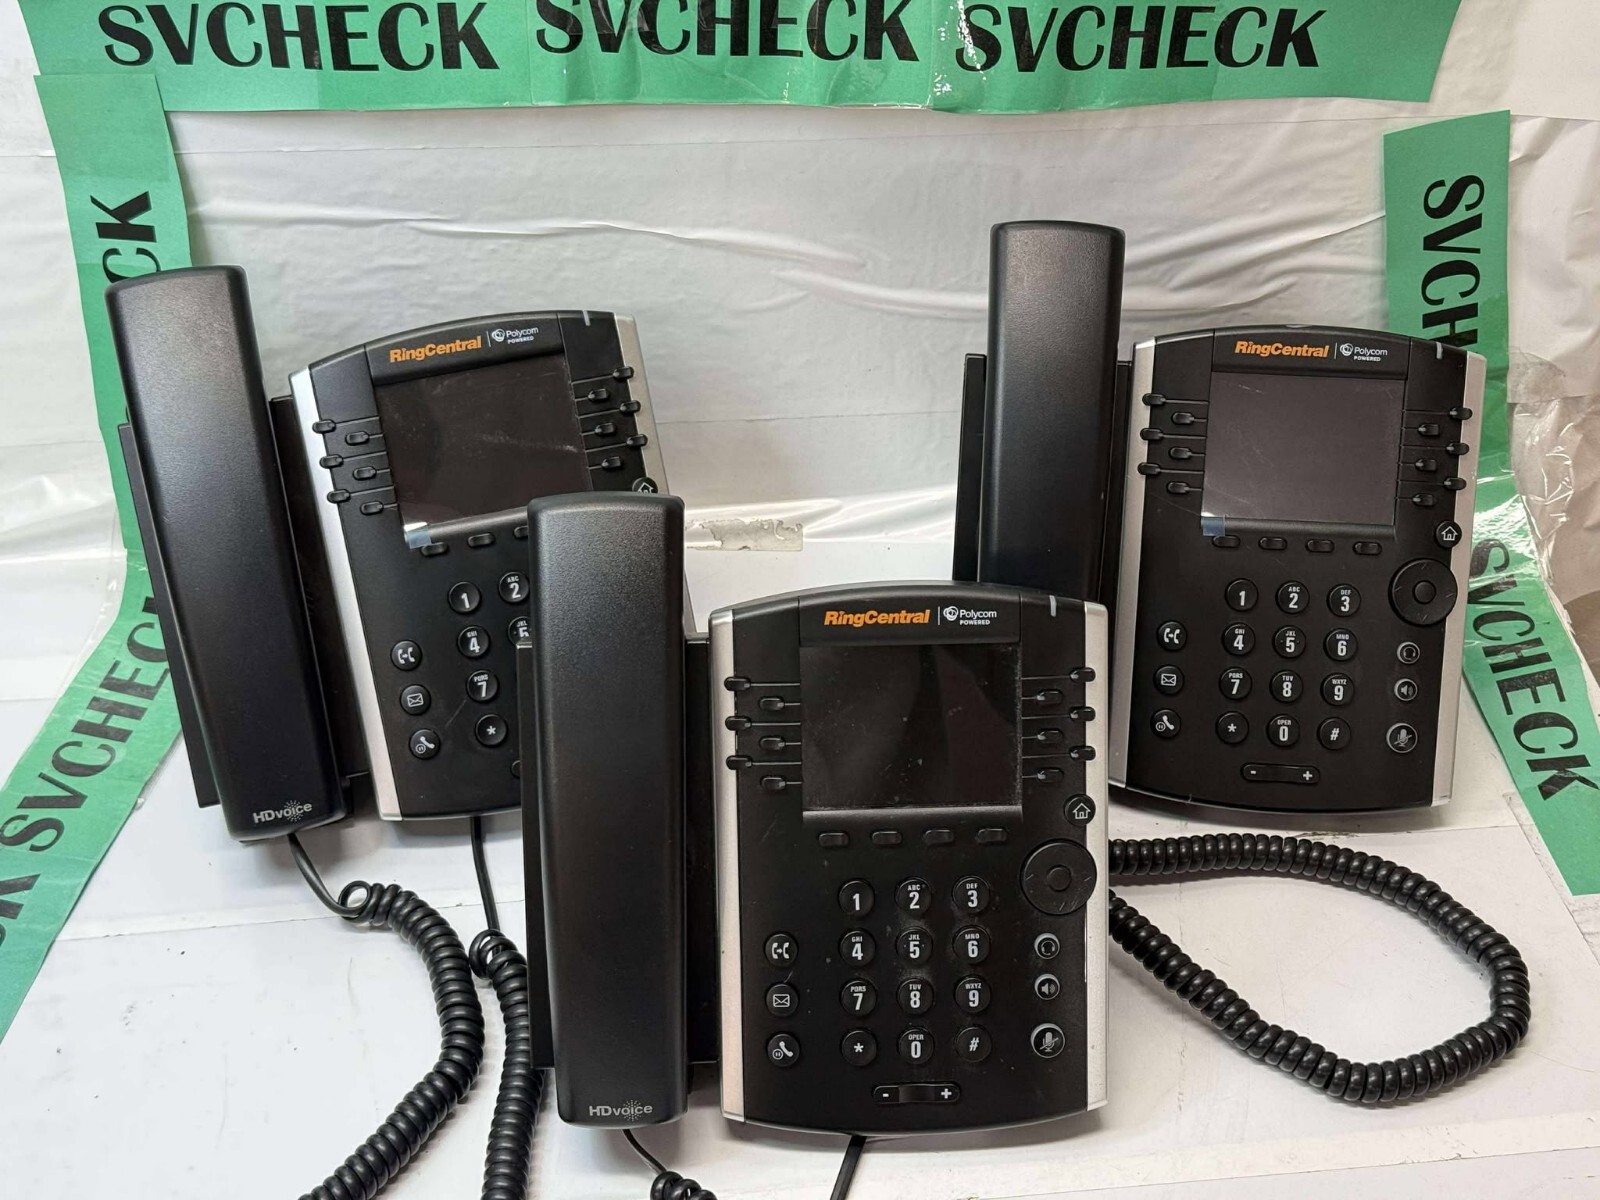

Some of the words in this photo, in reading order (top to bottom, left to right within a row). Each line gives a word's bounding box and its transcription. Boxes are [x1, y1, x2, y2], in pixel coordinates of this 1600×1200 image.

[102, 2, 500, 71] SVCHECK
[536, 0, 920, 62] SVCHECK
[955, 4, 1327, 73] SVCHECK
[506, 327, 539, 338] Polycom
[507, 335, 534, 344] POWERED
[389, 336, 482, 363] RingCentral
[1234, 340, 1330, 358] RingCentral
[1354, 346, 1388, 357] Polycom
[510, 582, 521, 598] 2
[1239, 590, 1246, 606] 1
[461, 593, 470, 609] 1
[1288, 593, 1299, 609] 2
[1340, 596, 1350, 612] 3
[824, 609, 931, 628] RingCentral
[959, 609, 997, 619] Polycom
[470, 637, 480, 653] 4
[1233, 634, 1244, 650] 4
[1285, 637, 1295, 653] 5
[1337, 640, 1347, 656] 6
[1467, 539, 1600, 801] SVCHECK
[477, 681, 487, 697] 7
[1230, 679, 1240, 695] 7
[1282, 681, 1292, 697] 8
[1334, 685, 1344, 701] 9
[0, 597, 170, 852] SVCHEC
[1279, 726, 1289, 742] 0
[852, 893, 860, 911] 1
[909, 891, 920, 909] 2
[967, 890, 978, 908] 3
[851, 943, 864, 960] 4
[909, 941, 920, 959] 5
[967, 940, 978, 958] 6
[853, 993, 863, 1011] 7
[910, 990, 921, 1009] 8
[968, 990, 979, 1008] 9
[908, 1033, 924, 1041] OPER
[910, 1041, 921, 1059] 0
